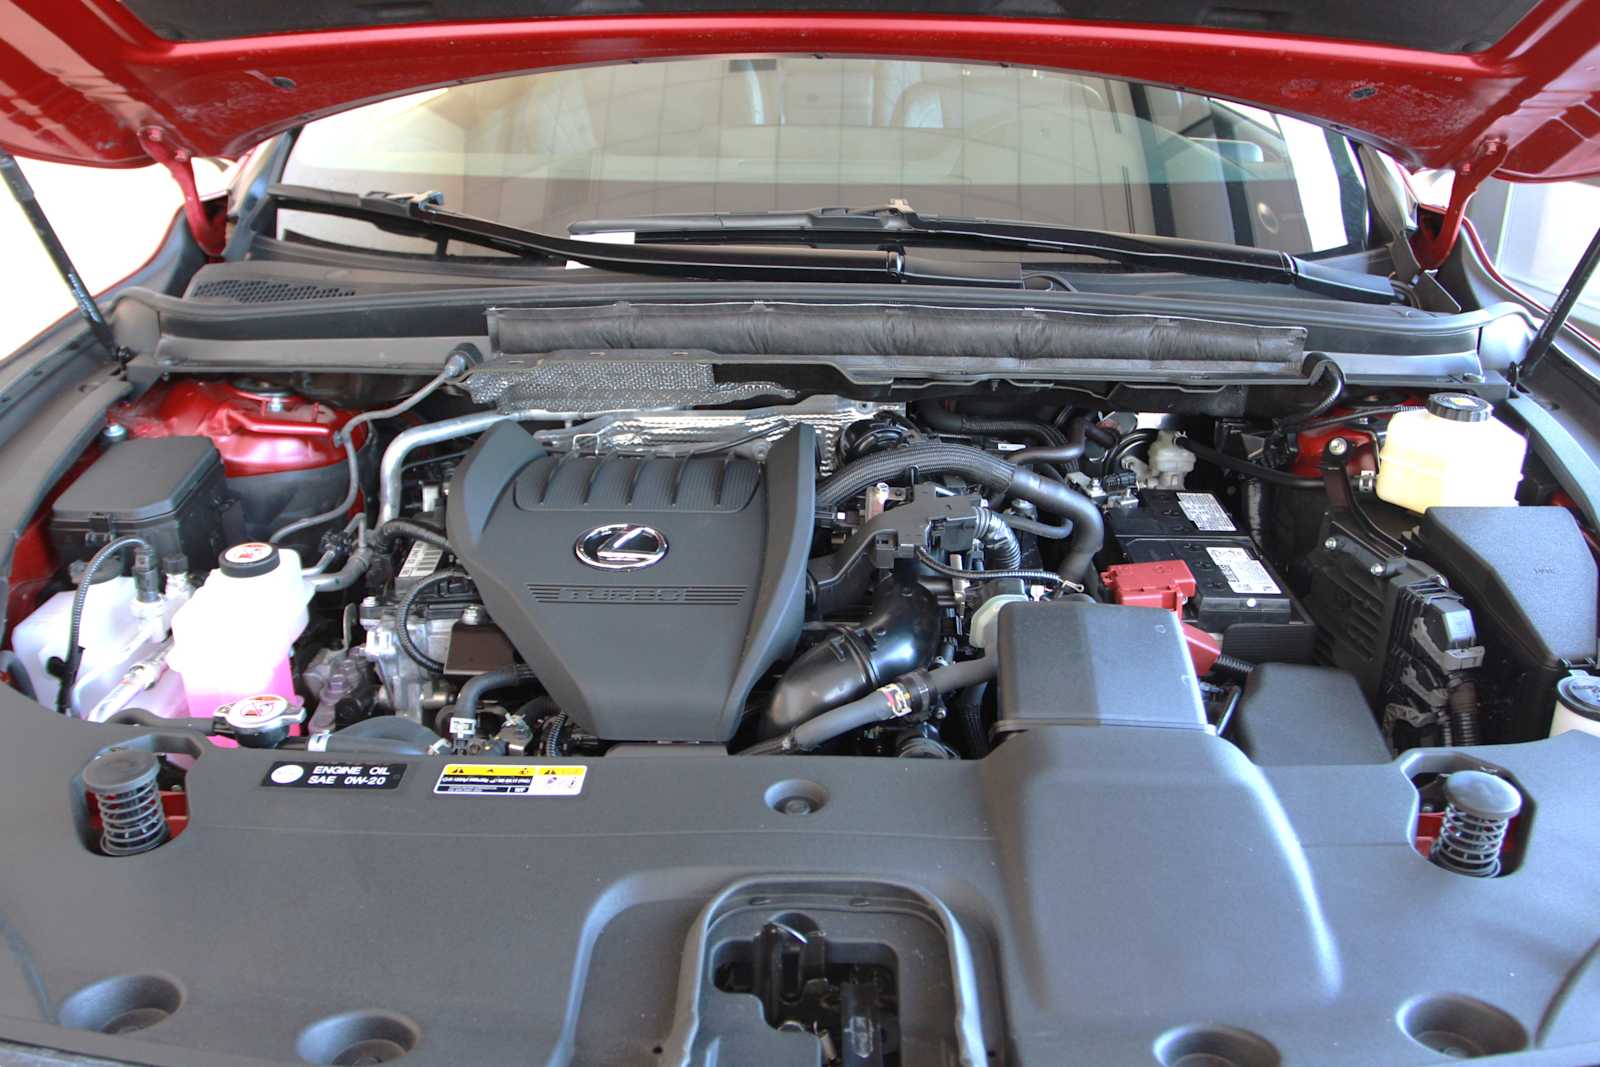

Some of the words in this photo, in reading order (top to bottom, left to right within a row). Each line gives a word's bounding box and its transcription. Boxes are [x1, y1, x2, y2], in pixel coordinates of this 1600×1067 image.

[312, 766, 363, 775] ENGINE
[369, 767, 391, 775] OIL
[307, 775, 337, 784] SAE
[344, 776, 386, 785] 0W-20
